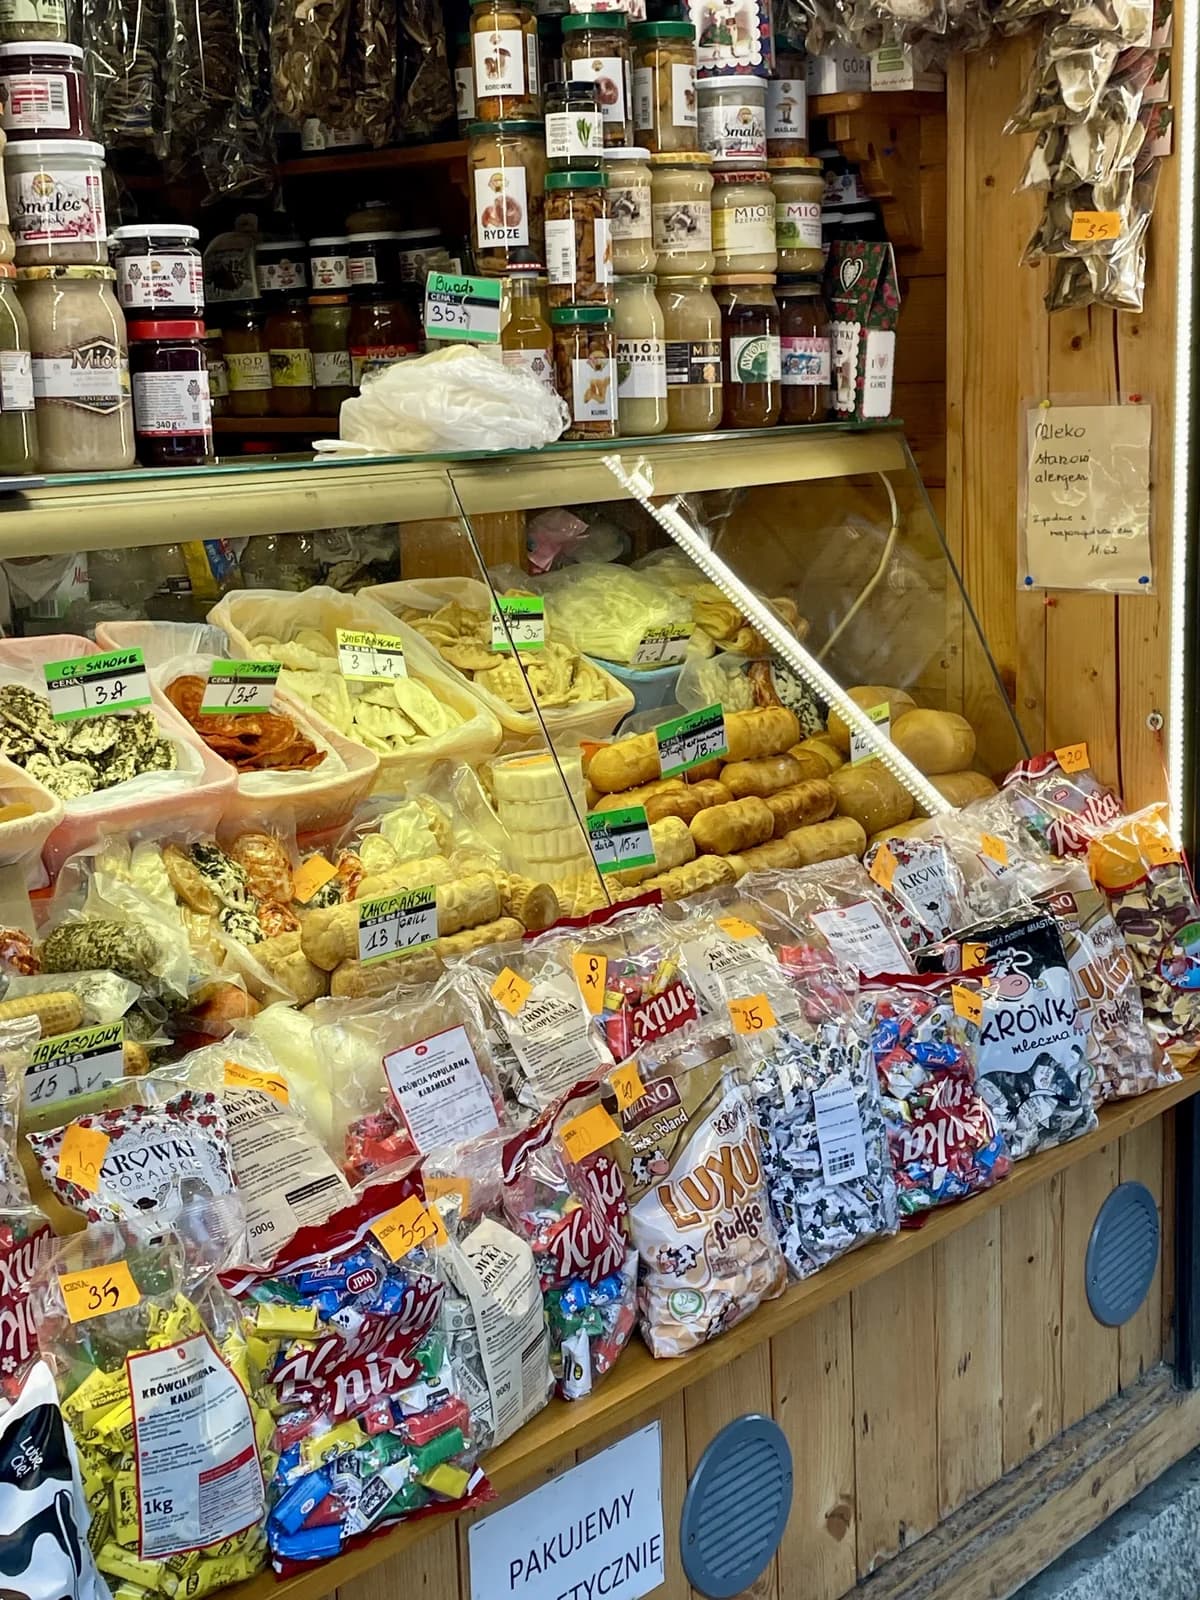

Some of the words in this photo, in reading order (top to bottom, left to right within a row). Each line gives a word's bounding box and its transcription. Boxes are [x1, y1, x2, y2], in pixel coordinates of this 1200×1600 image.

[484, 229, 520, 242] RYDZE
[156, 421, 171, 429] 340
[1035, 423, 1087, 440] Mleko
[1034, 470, 1088, 491] alergen
[633, 981, 689, 1040] mix
[744, 1007, 764, 1029] 35
[1097, 999, 1132, 1030] fudge
[29, 1073, 58, 1103] 15
[398, 1076, 429, 1095] KRÓWCIA
[427, 1057, 471, 1081] POPULARNA
[653, 1108, 690, 1137] Poland
[249, 1218, 276, 1238] 500g
[398, 1211, 430, 1248] 35
[711, 1203, 764, 1251] fudge
[62, 1280, 90, 1293] CENA:
[88, 1278, 119, 1311] 35
[350, 1272, 375, 1291] JPM
[142, 1377, 187, 1400] KRÓWCIA
[143, 1498, 174, 1517] 1kg
[509, 1489, 634, 1591] PAKUJEMY
[557, 1534, 662, 1600] TYCZNIE
